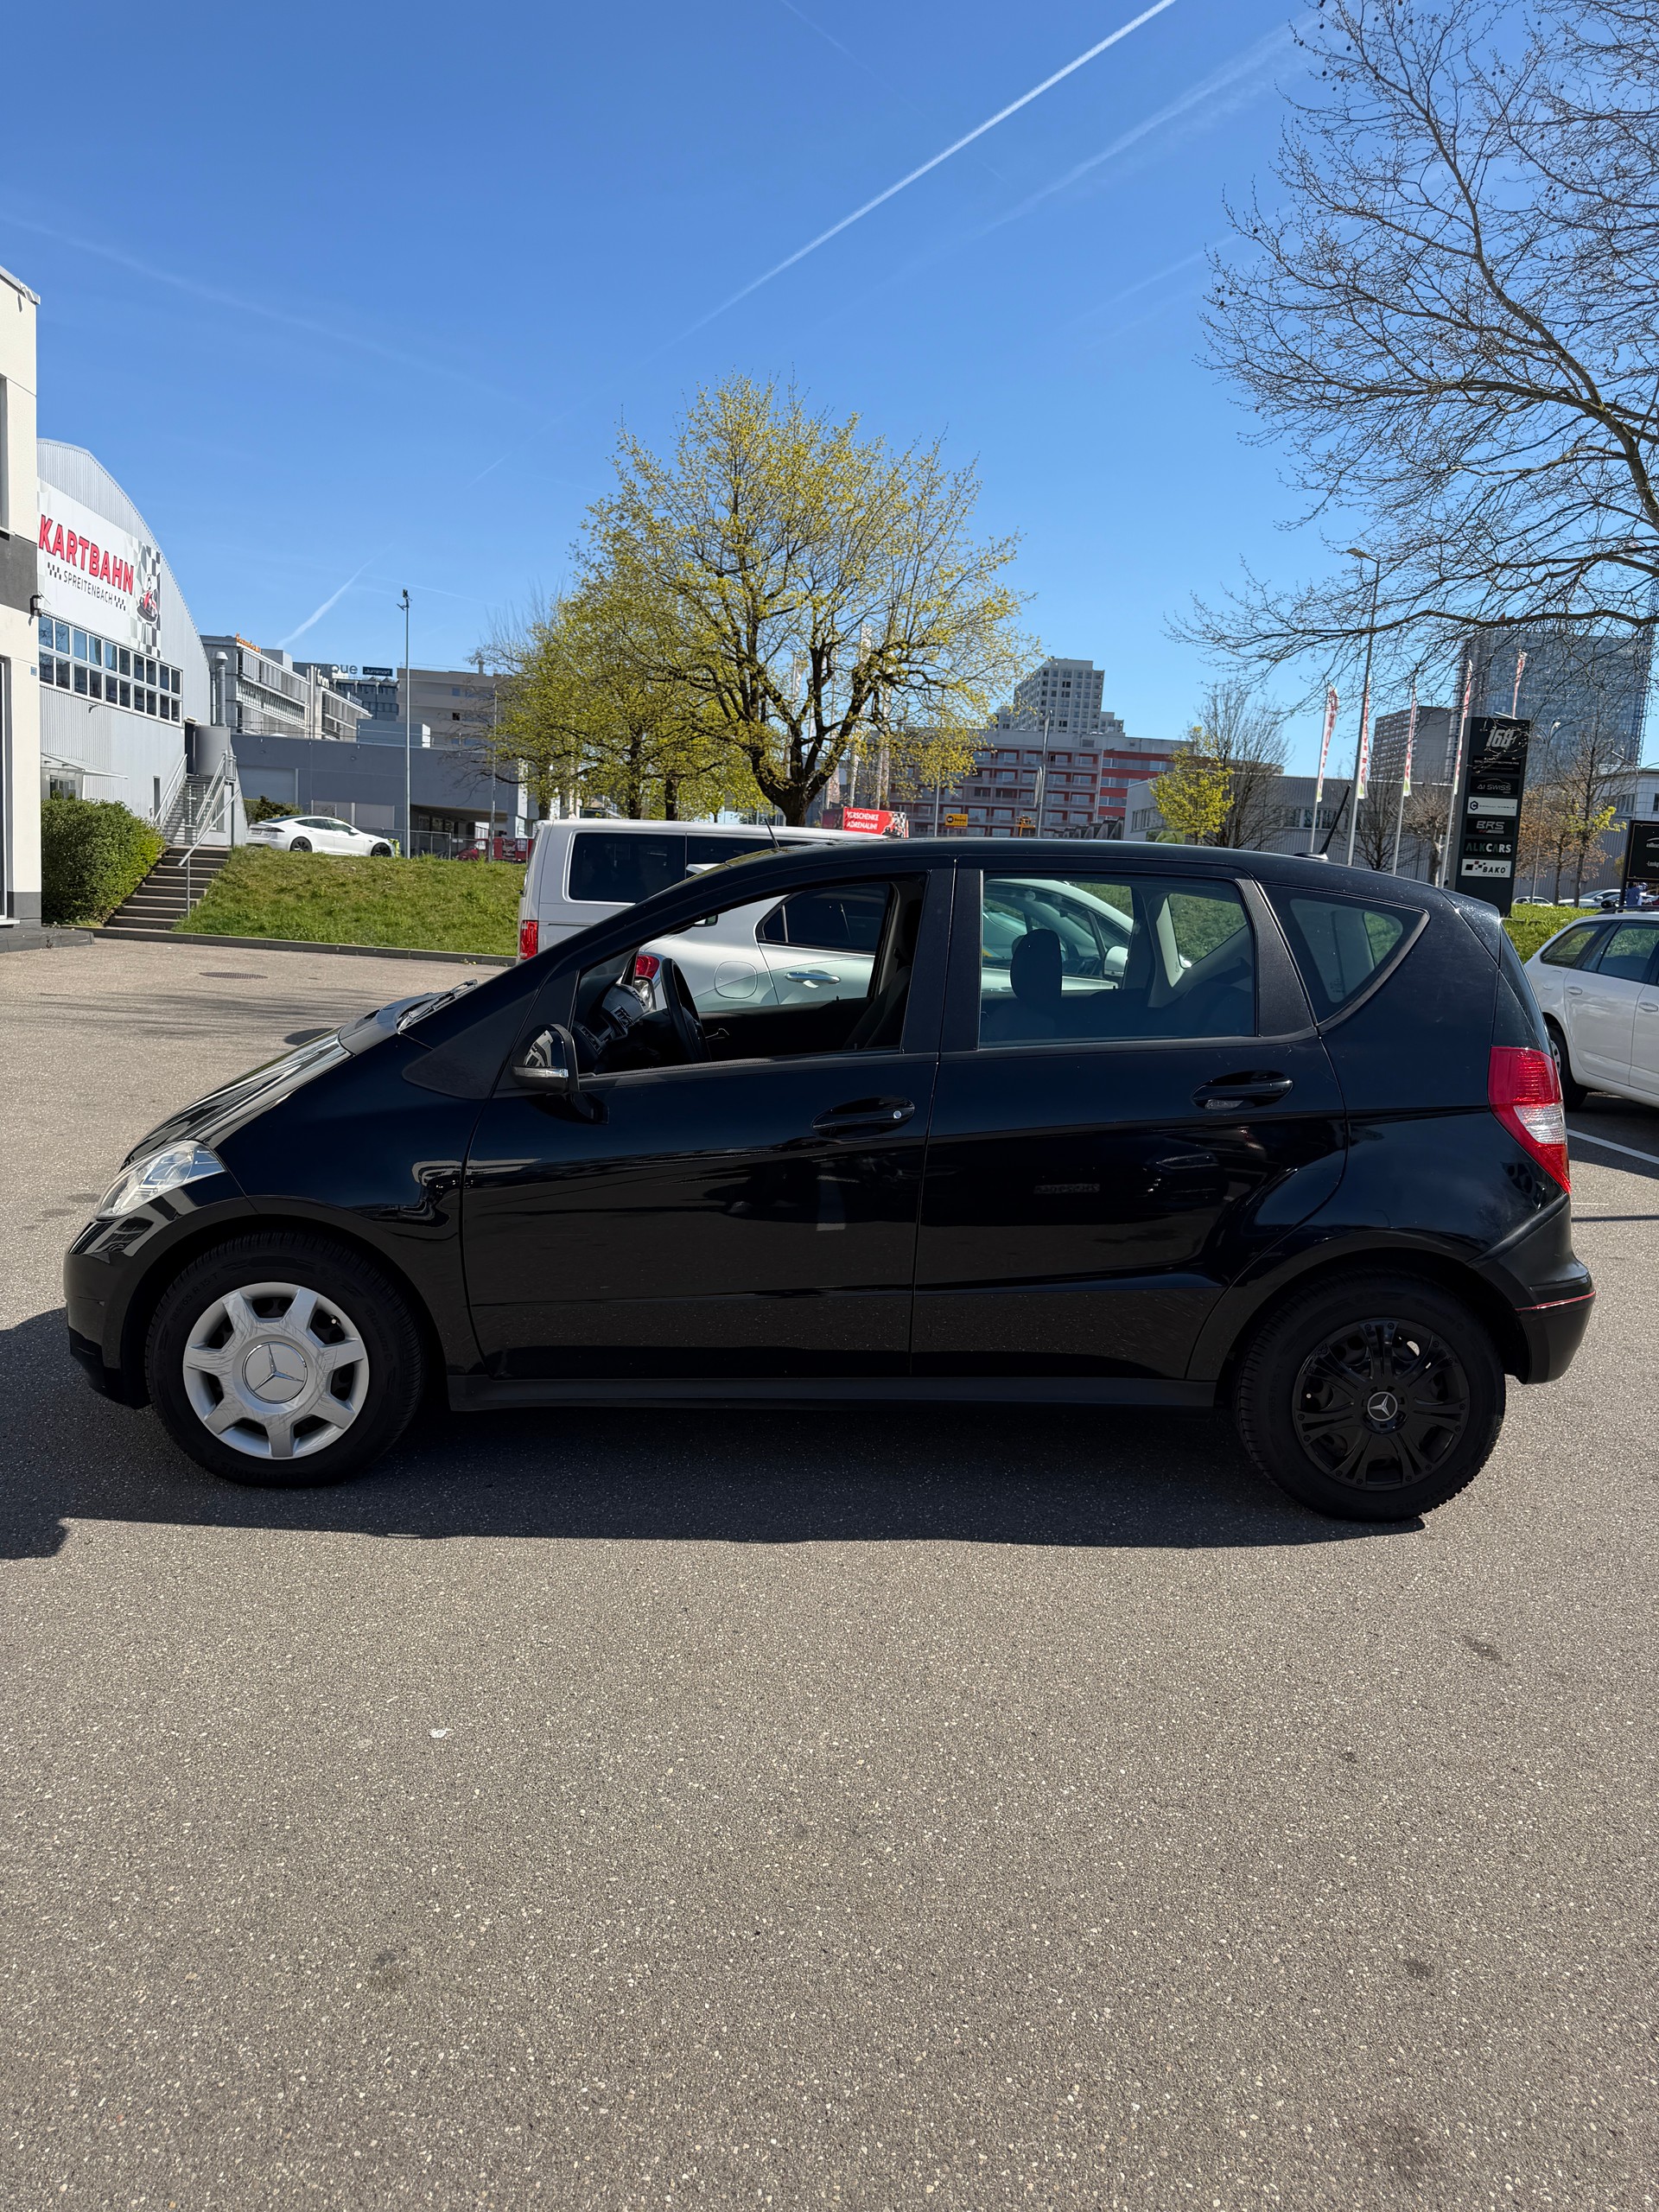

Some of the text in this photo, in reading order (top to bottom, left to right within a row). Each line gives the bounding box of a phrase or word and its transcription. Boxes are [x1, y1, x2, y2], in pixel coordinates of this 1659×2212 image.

[38, 513, 134, 596] KARTBAHN
[63, 570, 113, 605] SPREITENBACH
[1485, 728, 1514, 747] 168
[847, 811, 880, 821] VERSCHENKE
[847, 821, 878, 830] ADRENALIN!
[1476, 821, 1504, 830] BRS
[1465, 842, 1512, 854] ALKCARS
